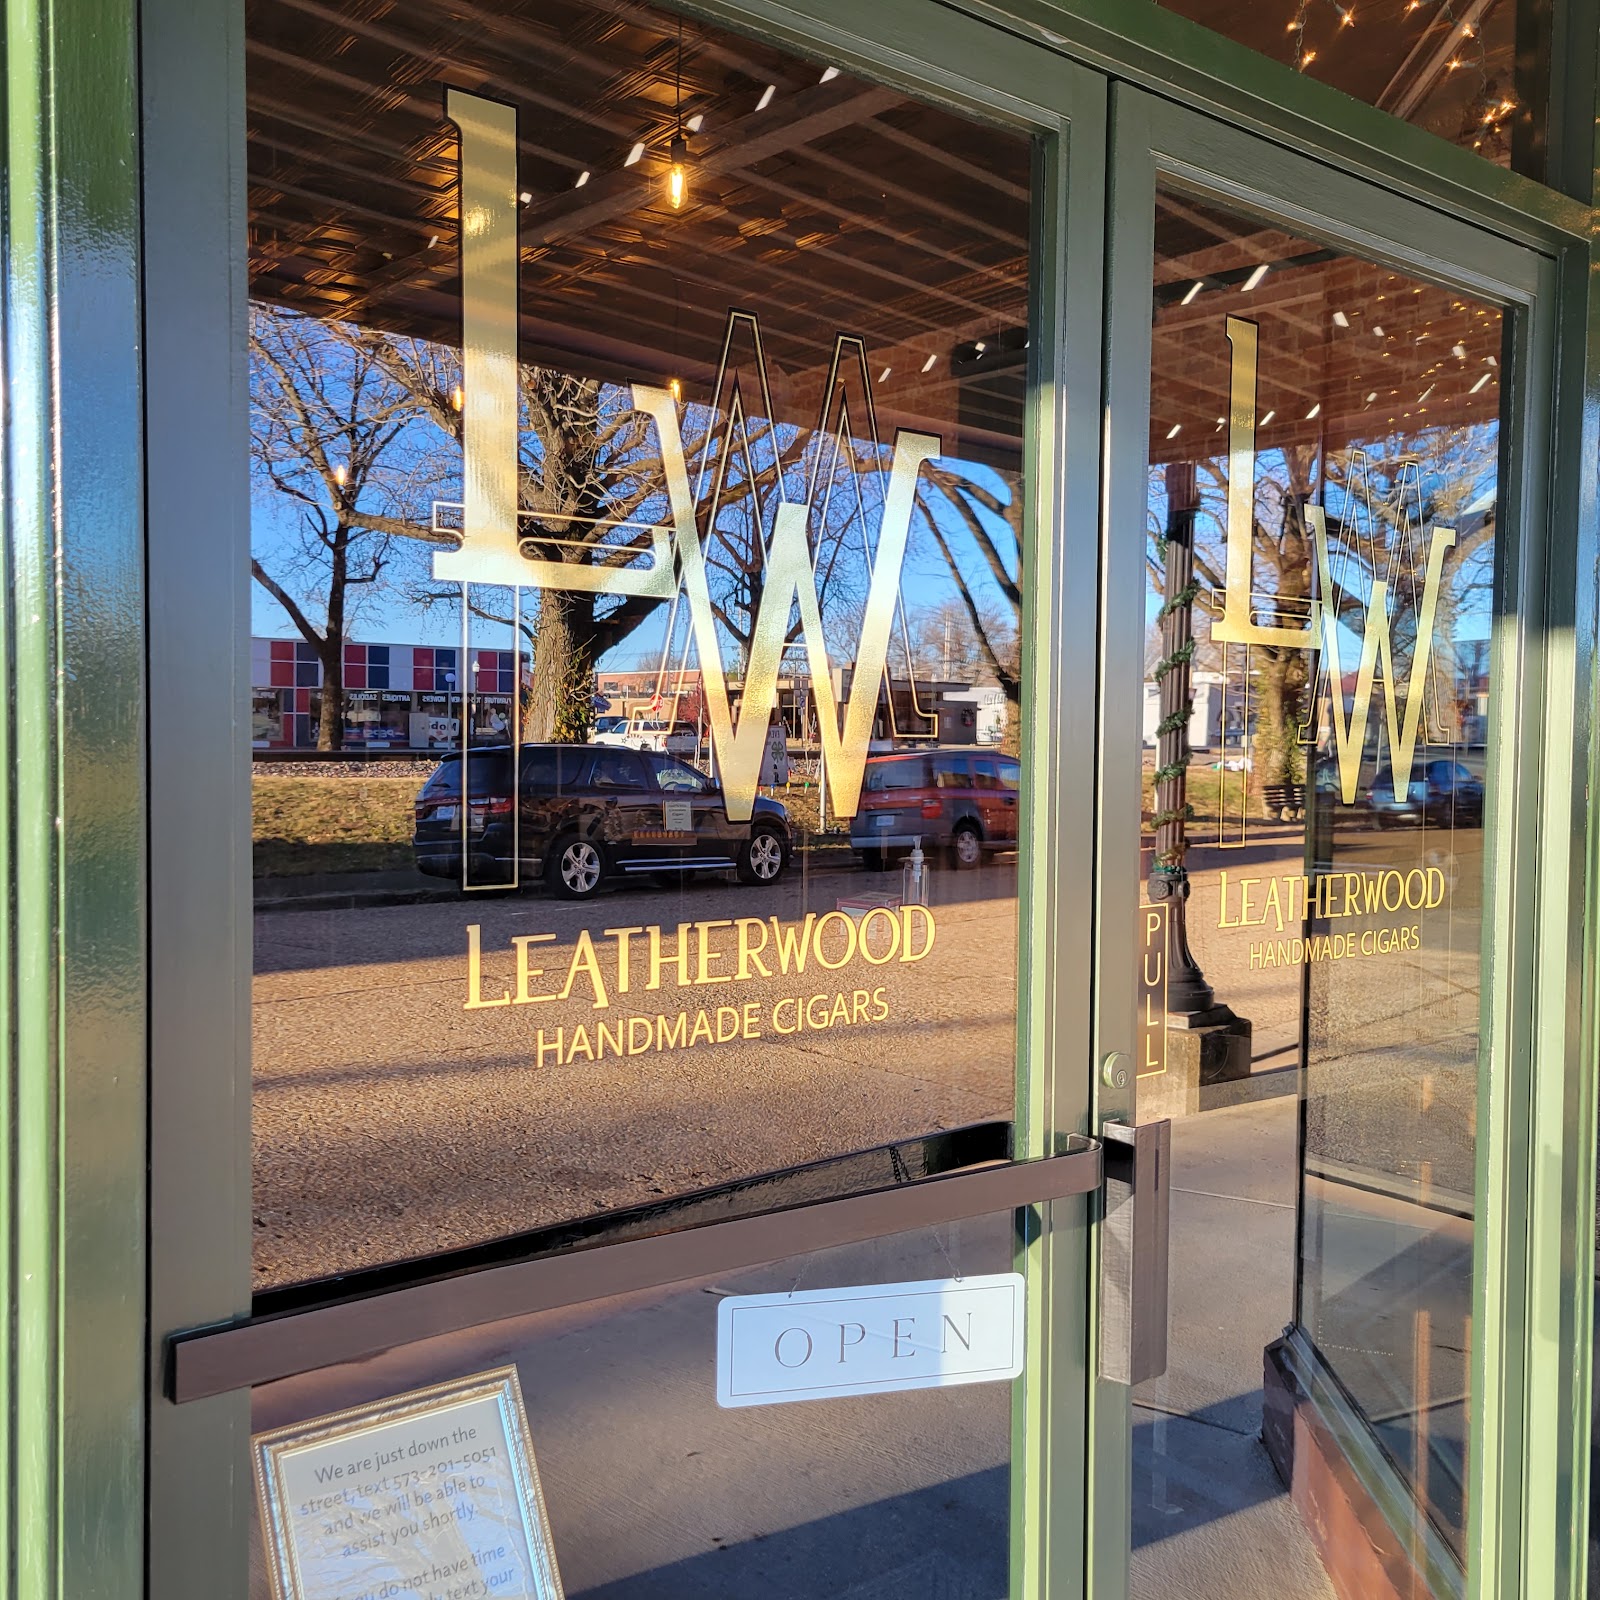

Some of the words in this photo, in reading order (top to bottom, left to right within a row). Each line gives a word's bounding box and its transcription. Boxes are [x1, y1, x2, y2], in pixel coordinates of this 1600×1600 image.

[1217, 866, 1446, 932] LEATHERWOOD
[463, 904, 937, 1010] LEATHERWOOD
[1249, 931, 1356, 970] HANDMADE
[1360, 925, 1420, 956] CIGARS
[1144, 912, 1162, 1067] PULL
[536, 1002, 762, 1068] HANDMADE
[772, 986, 890, 1036] CIGARS
[773, 1312, 973, 1369] OPEN
[300, 1488, 355, 1516] street,
[356, 1476, 391, 1498] text
[393, 1446, 496, 1492] 573-201-5051
[314, 1465, 344, 1484] We
[347, 1459, 372, 1475] are
[373, 1447, 406, 1472] just
[408, 1434, 449, 1458] down
[452, 1426, 477, 1444] the
[323, 1512, 353, 1535] and
[359, 1508, 381, 1525] we
[386, 1494, 411, 1516] will
[414, 1488, 434, 1506] be
[436, 1476, 466, 1502] able
[470, 1474, 485, 1488] to
[342, 1529, 388, 1558] assist
[390, 1522, 420, 1546] you
[379, 1581, 400, 1599] do
[402, 1571, 430, 1592] not
[432, 1558, 469, 1582] have
[471, 1545, 505, 1568] time
[446, 1580, 479, 1600] text
[481, 1567, 514, 1596] your
